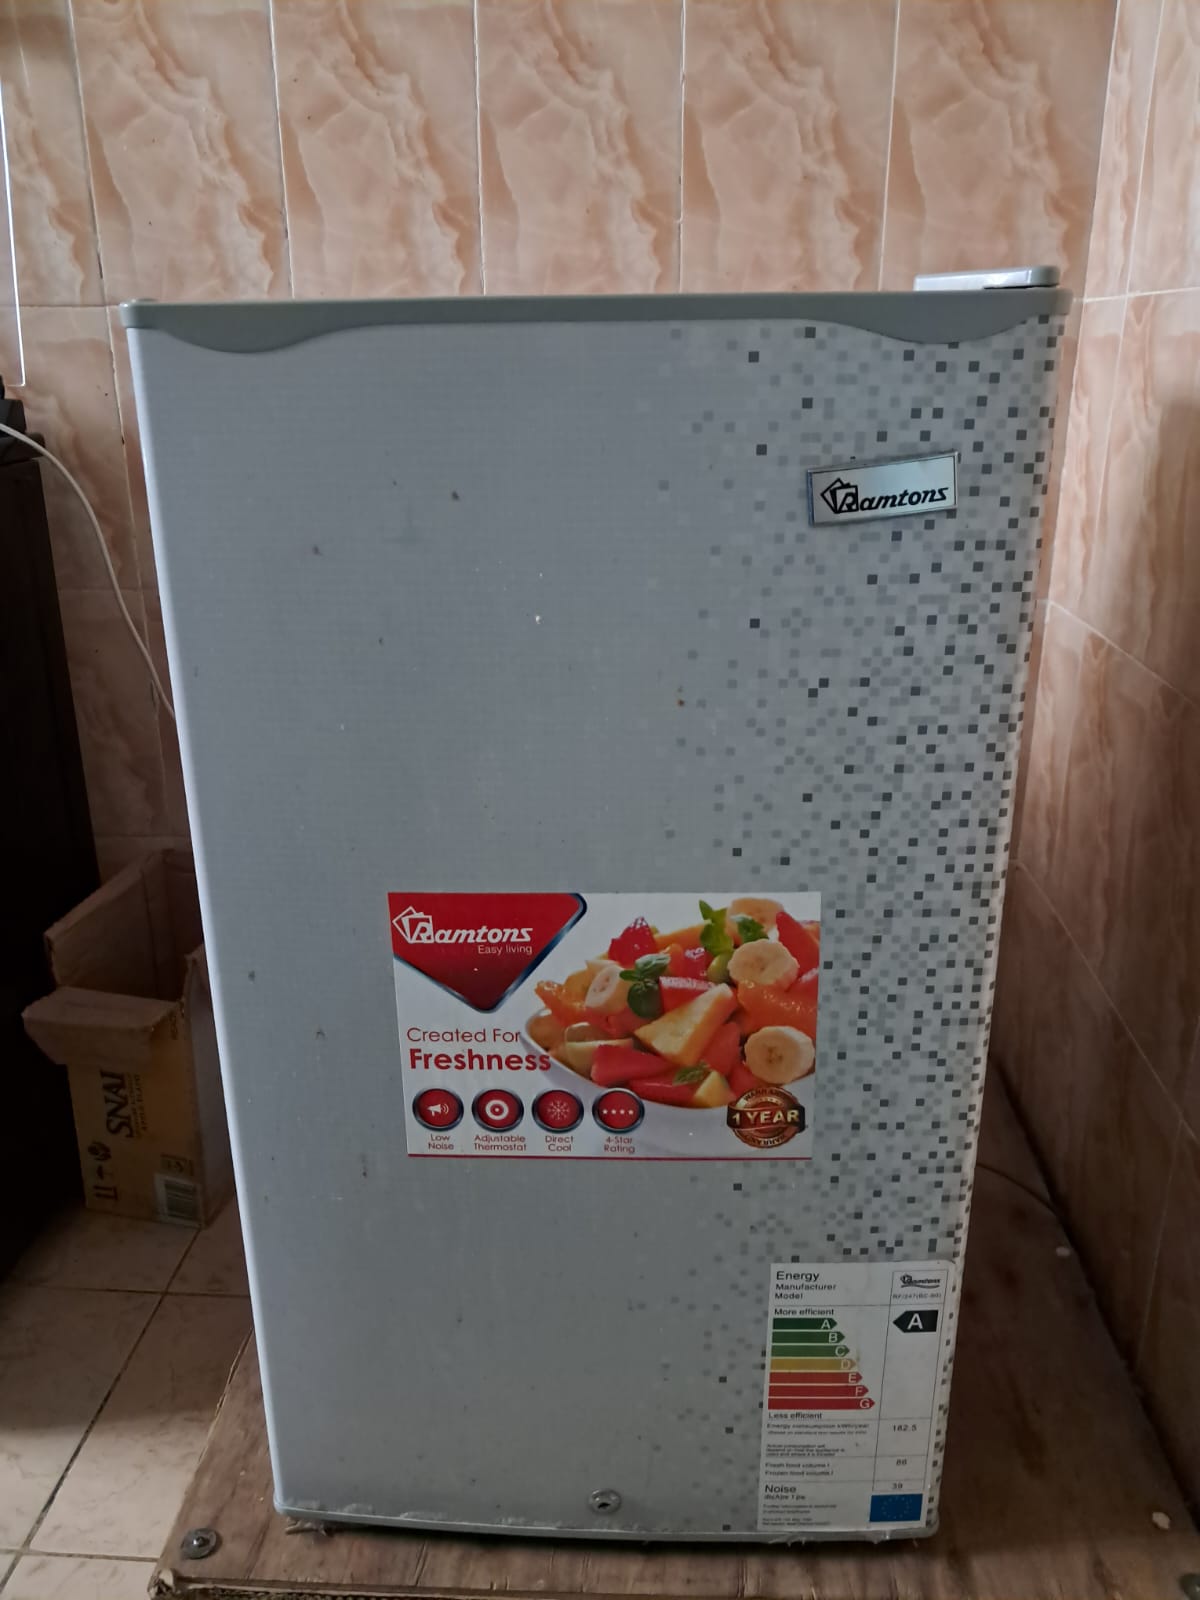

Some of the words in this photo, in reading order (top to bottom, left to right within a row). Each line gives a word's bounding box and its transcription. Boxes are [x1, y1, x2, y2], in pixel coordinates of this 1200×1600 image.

[829, 483, 949, 513] Ramtons
[402, 914, 533, 944] Ramtons
[478, 944, 503, 956] Easy
[505, 944, 533, 955] living
[406, 1027, 487, 1043] Created
[492, 1028, 521, 1043] For
[409, 1048, 552, 1071] Freshness
[731, 1112, 741, 1126] 1
[746, 1109, 800, 1124] YEAR
[430, 1133, 450, 1142] Low
[474, 1134, 526, 1145] Adjustable
[545, 1135, 575, 1144] Direct
[605, 1136, 634, 1145] 4-Star
[428, 1142, 455, 1151] Noise
[473, 1142, 527, 1152] Thermostat
[548, 1142, 573, 1152] Cool
[603, 1143, 636, 1154] Rating
[775, 1270, 821, 1282] Energy
[775, 1282, 837, 1291] Manufacturer
[774, 1291, 804, 1300] Model
[774, 1308, 797, 1316] More
[799, 1307, 834, 1316] efficient
[820, 1319, 831, 1329] A
[907, 1313, 924, 1330] A
[828, 1333, 837, 1343] B
[835, 1346, 845, 1356] C
[841, 1359, 850, 1369] D
[849, 1373, 857, 1383] E
[855, 1386, 863, 1396] F
[859, 1399, 870, 1409] G
[768, 1412, 789, 1420] Less
[790, 1411, 822, 1420] efficient
[764, 1484, 797, 1494] Noise
